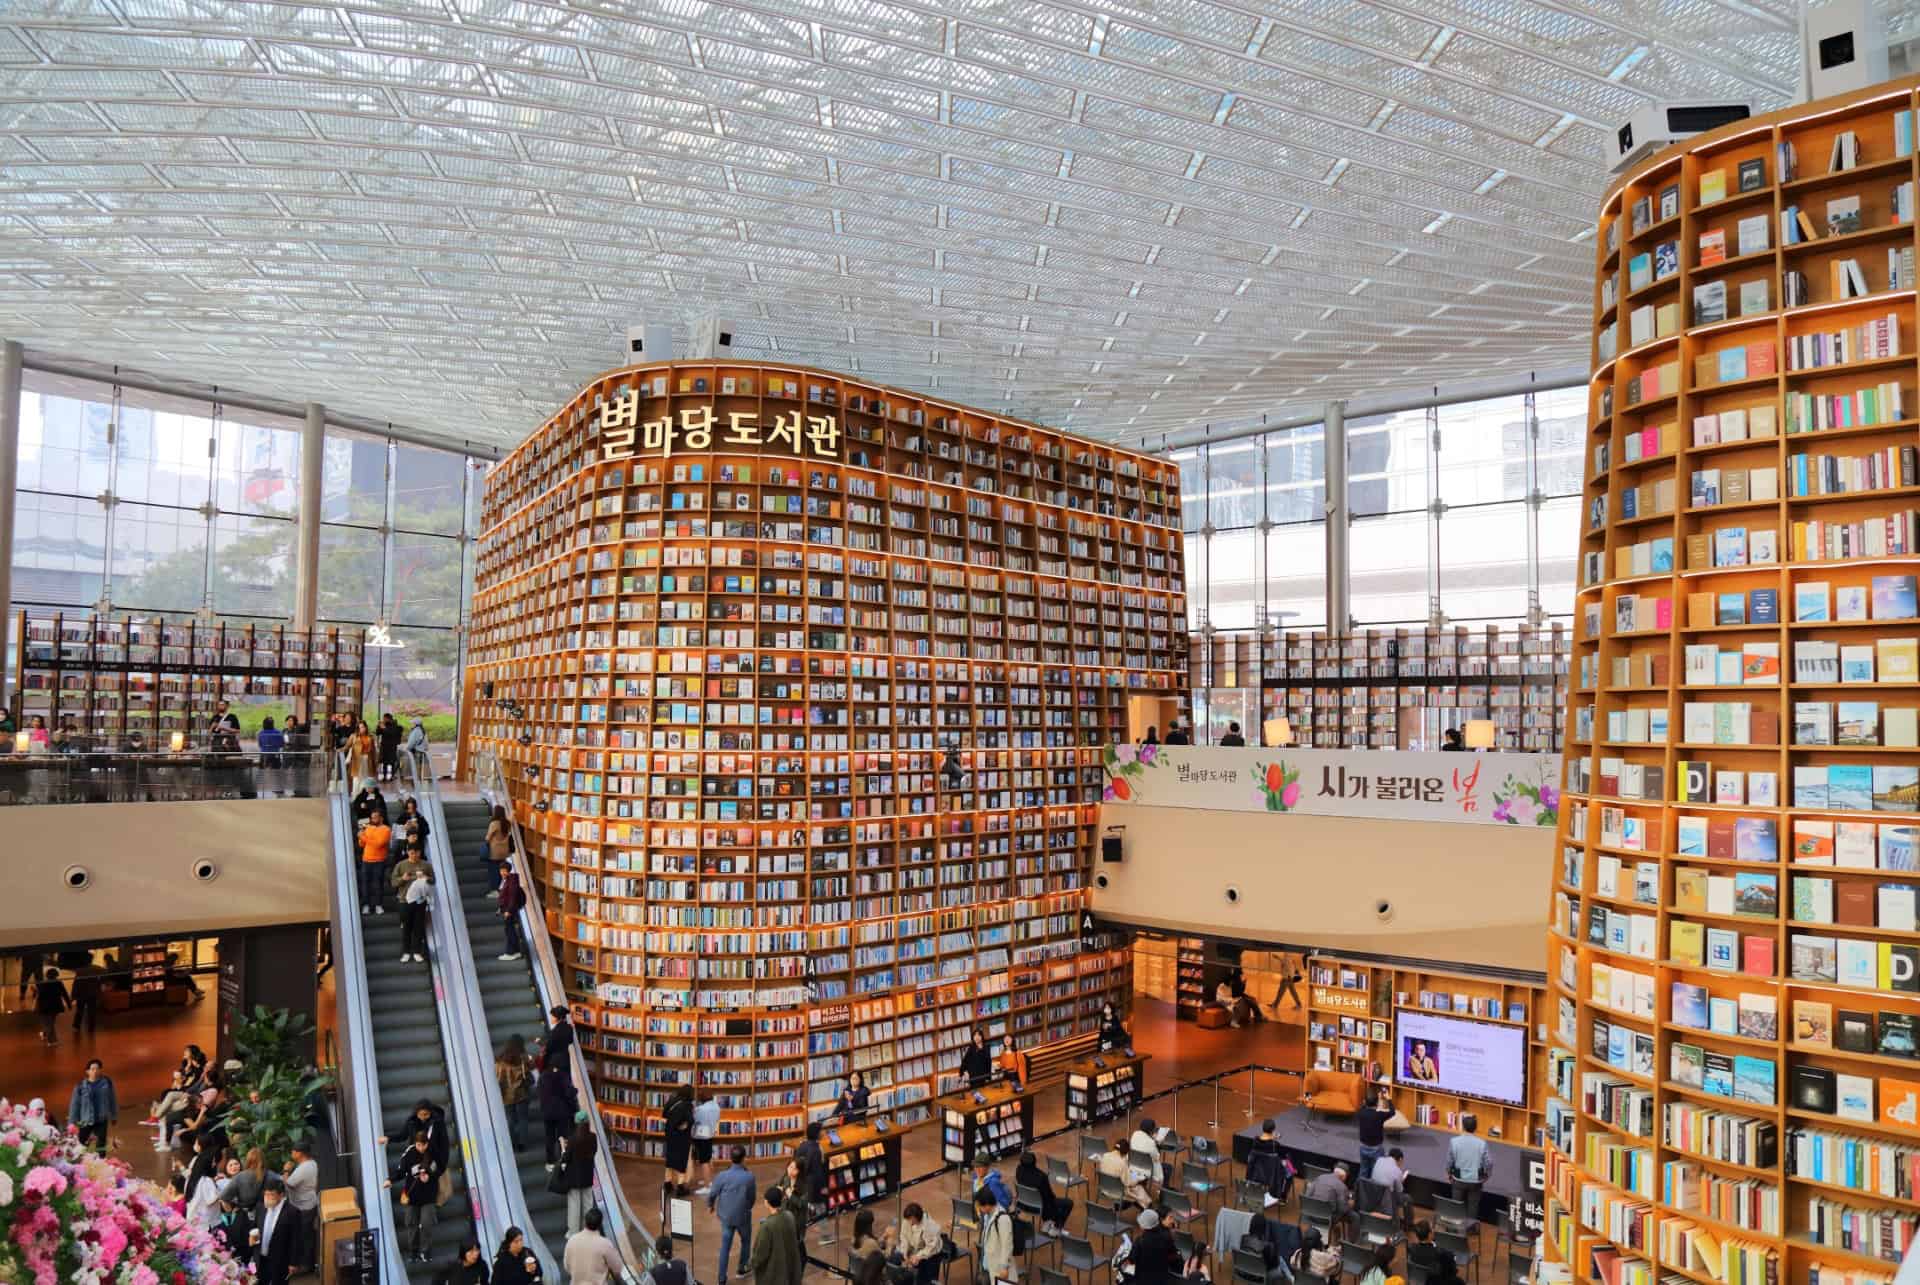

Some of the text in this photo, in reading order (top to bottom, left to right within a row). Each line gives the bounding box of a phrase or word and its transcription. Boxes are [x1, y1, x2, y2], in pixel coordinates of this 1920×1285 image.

[1317, 759, 1481, 813] 시가 불러온 봄
[1687, 770, 1704, 793] D
[1891, 953, 1914, 981] D
